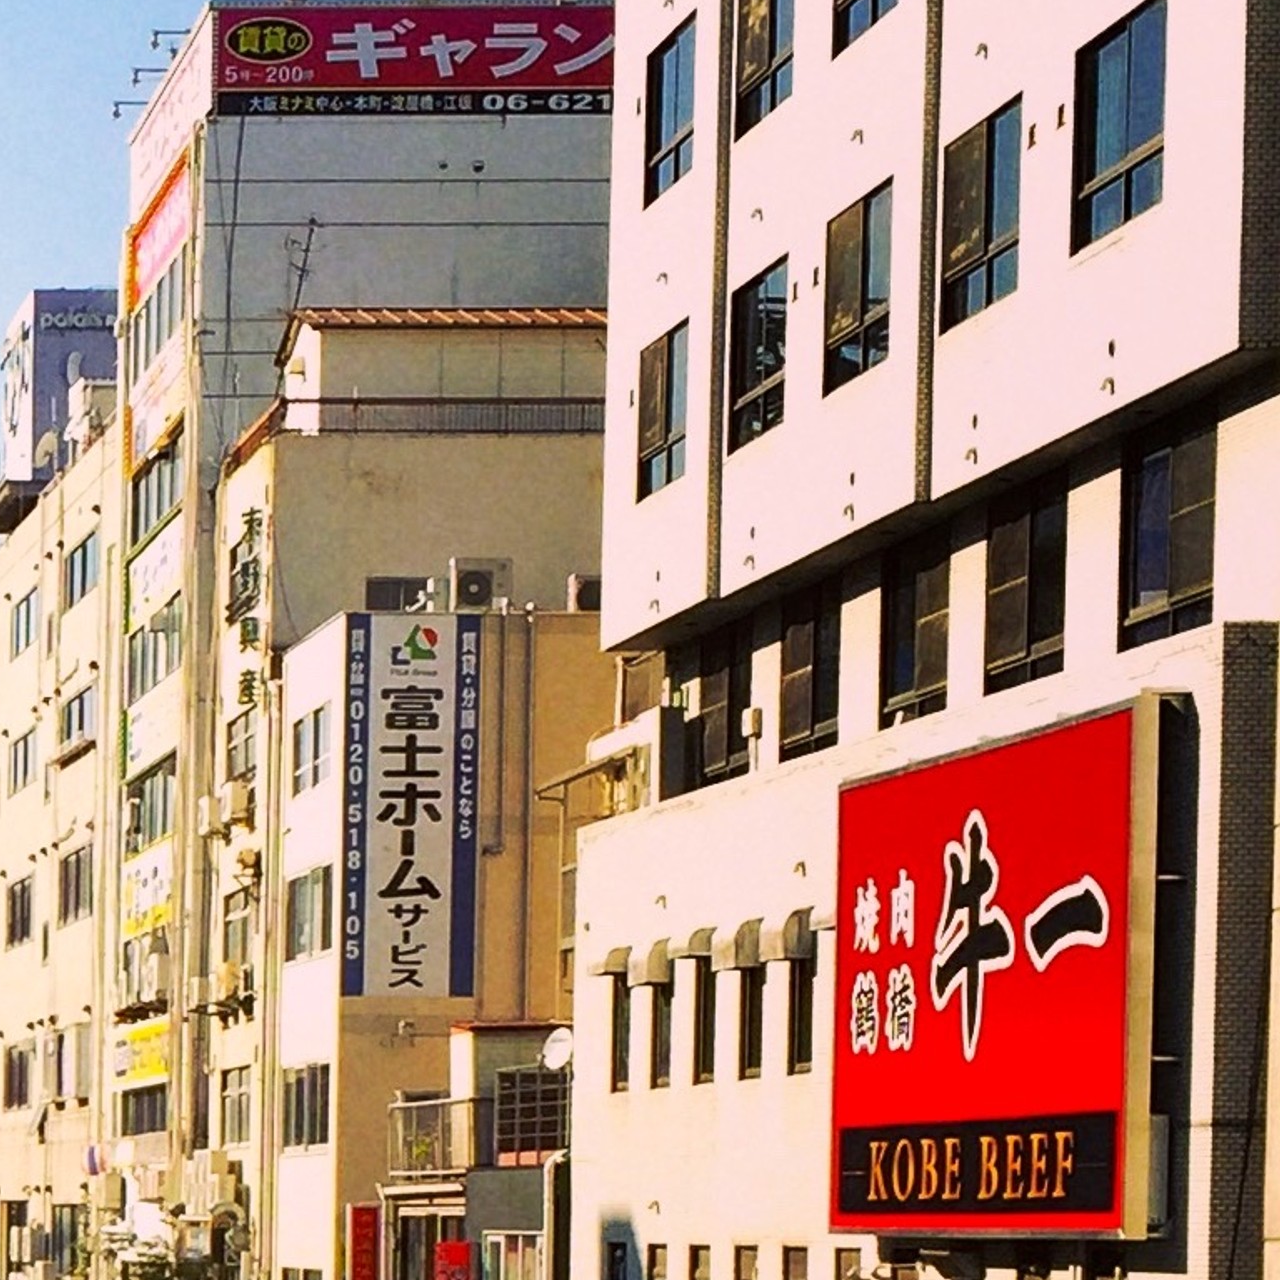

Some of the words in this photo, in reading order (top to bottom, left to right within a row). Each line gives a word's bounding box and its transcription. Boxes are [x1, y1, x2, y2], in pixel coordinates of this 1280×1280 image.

[237, 26, 305, 53] 賃貸の
[325, 18, 615, 78] ギャラン
[376, 684, 444, 989] 富士ホームサービス
[853, 868, 916, 954] 焼肉
[930, 808, 1109, 1063] 牛一
[866, 1137, 962, 1202] KOBE
[976, 1130, 1075, 1201] BEEF
